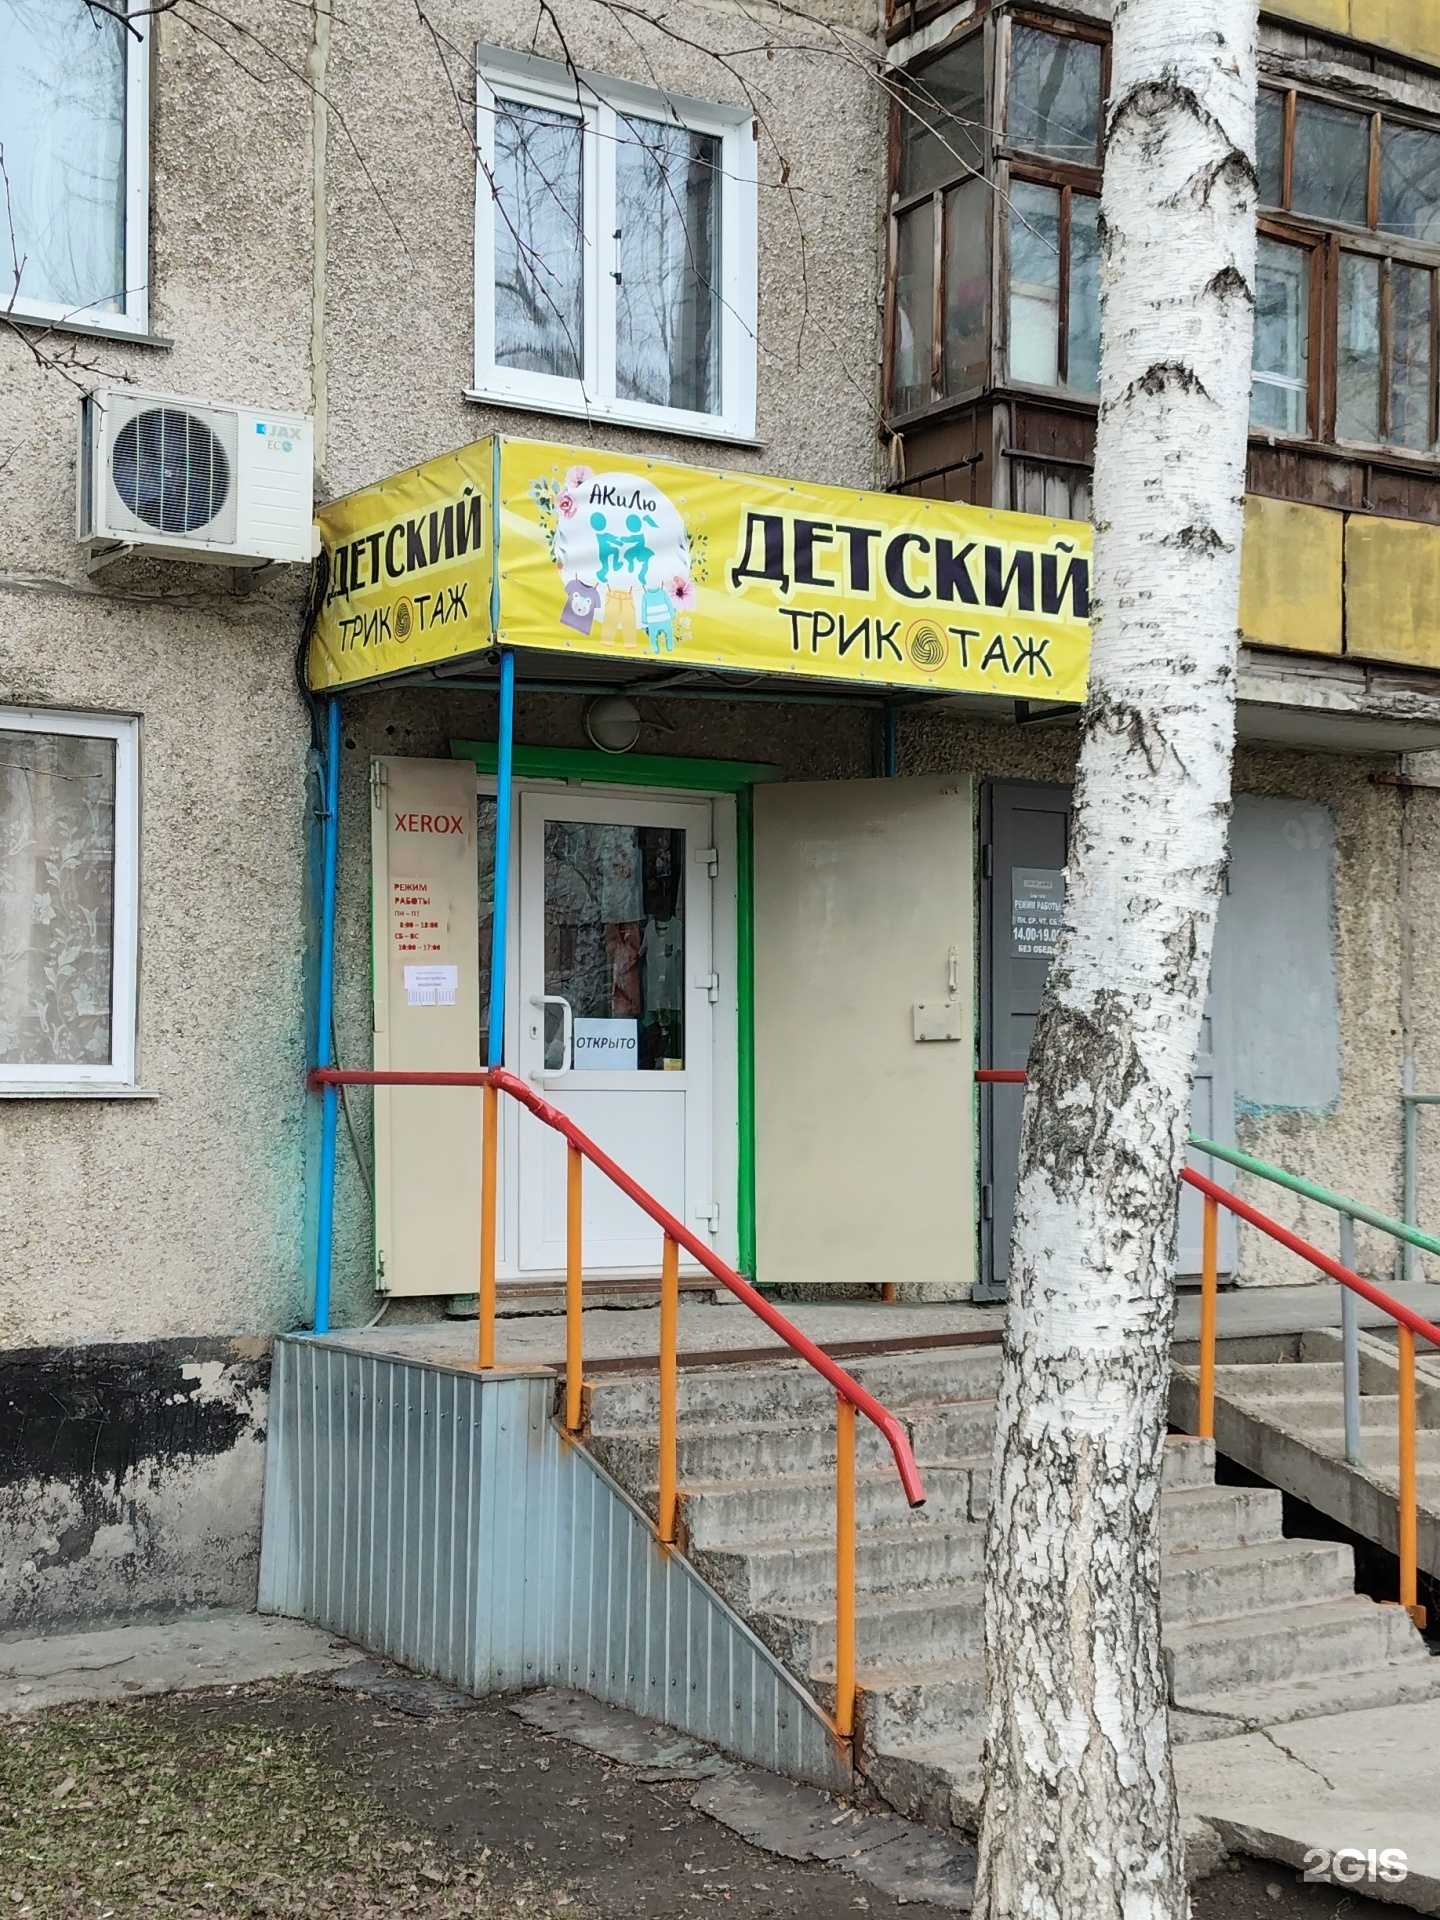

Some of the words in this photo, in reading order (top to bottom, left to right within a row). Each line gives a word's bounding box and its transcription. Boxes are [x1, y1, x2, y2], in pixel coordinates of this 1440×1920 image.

[269, 424, 303, 440] JAX
[327, 486, 482, 608] ДЕТСКИЙ
[732, 511, 1090, 619] ДЕТСКИЙ
[395, 813, 464, 835] XEROX
[394, 883, 427, 892] РЕЖИМ
[394, 897, 431, 905] РАБОТЫ
[1013, 927, 1060, 942] 14.00-19.0
[1033, 946, 1053, 954] ОБЕД
[576, 1037, 636, 1049] ОТКРЫТО
